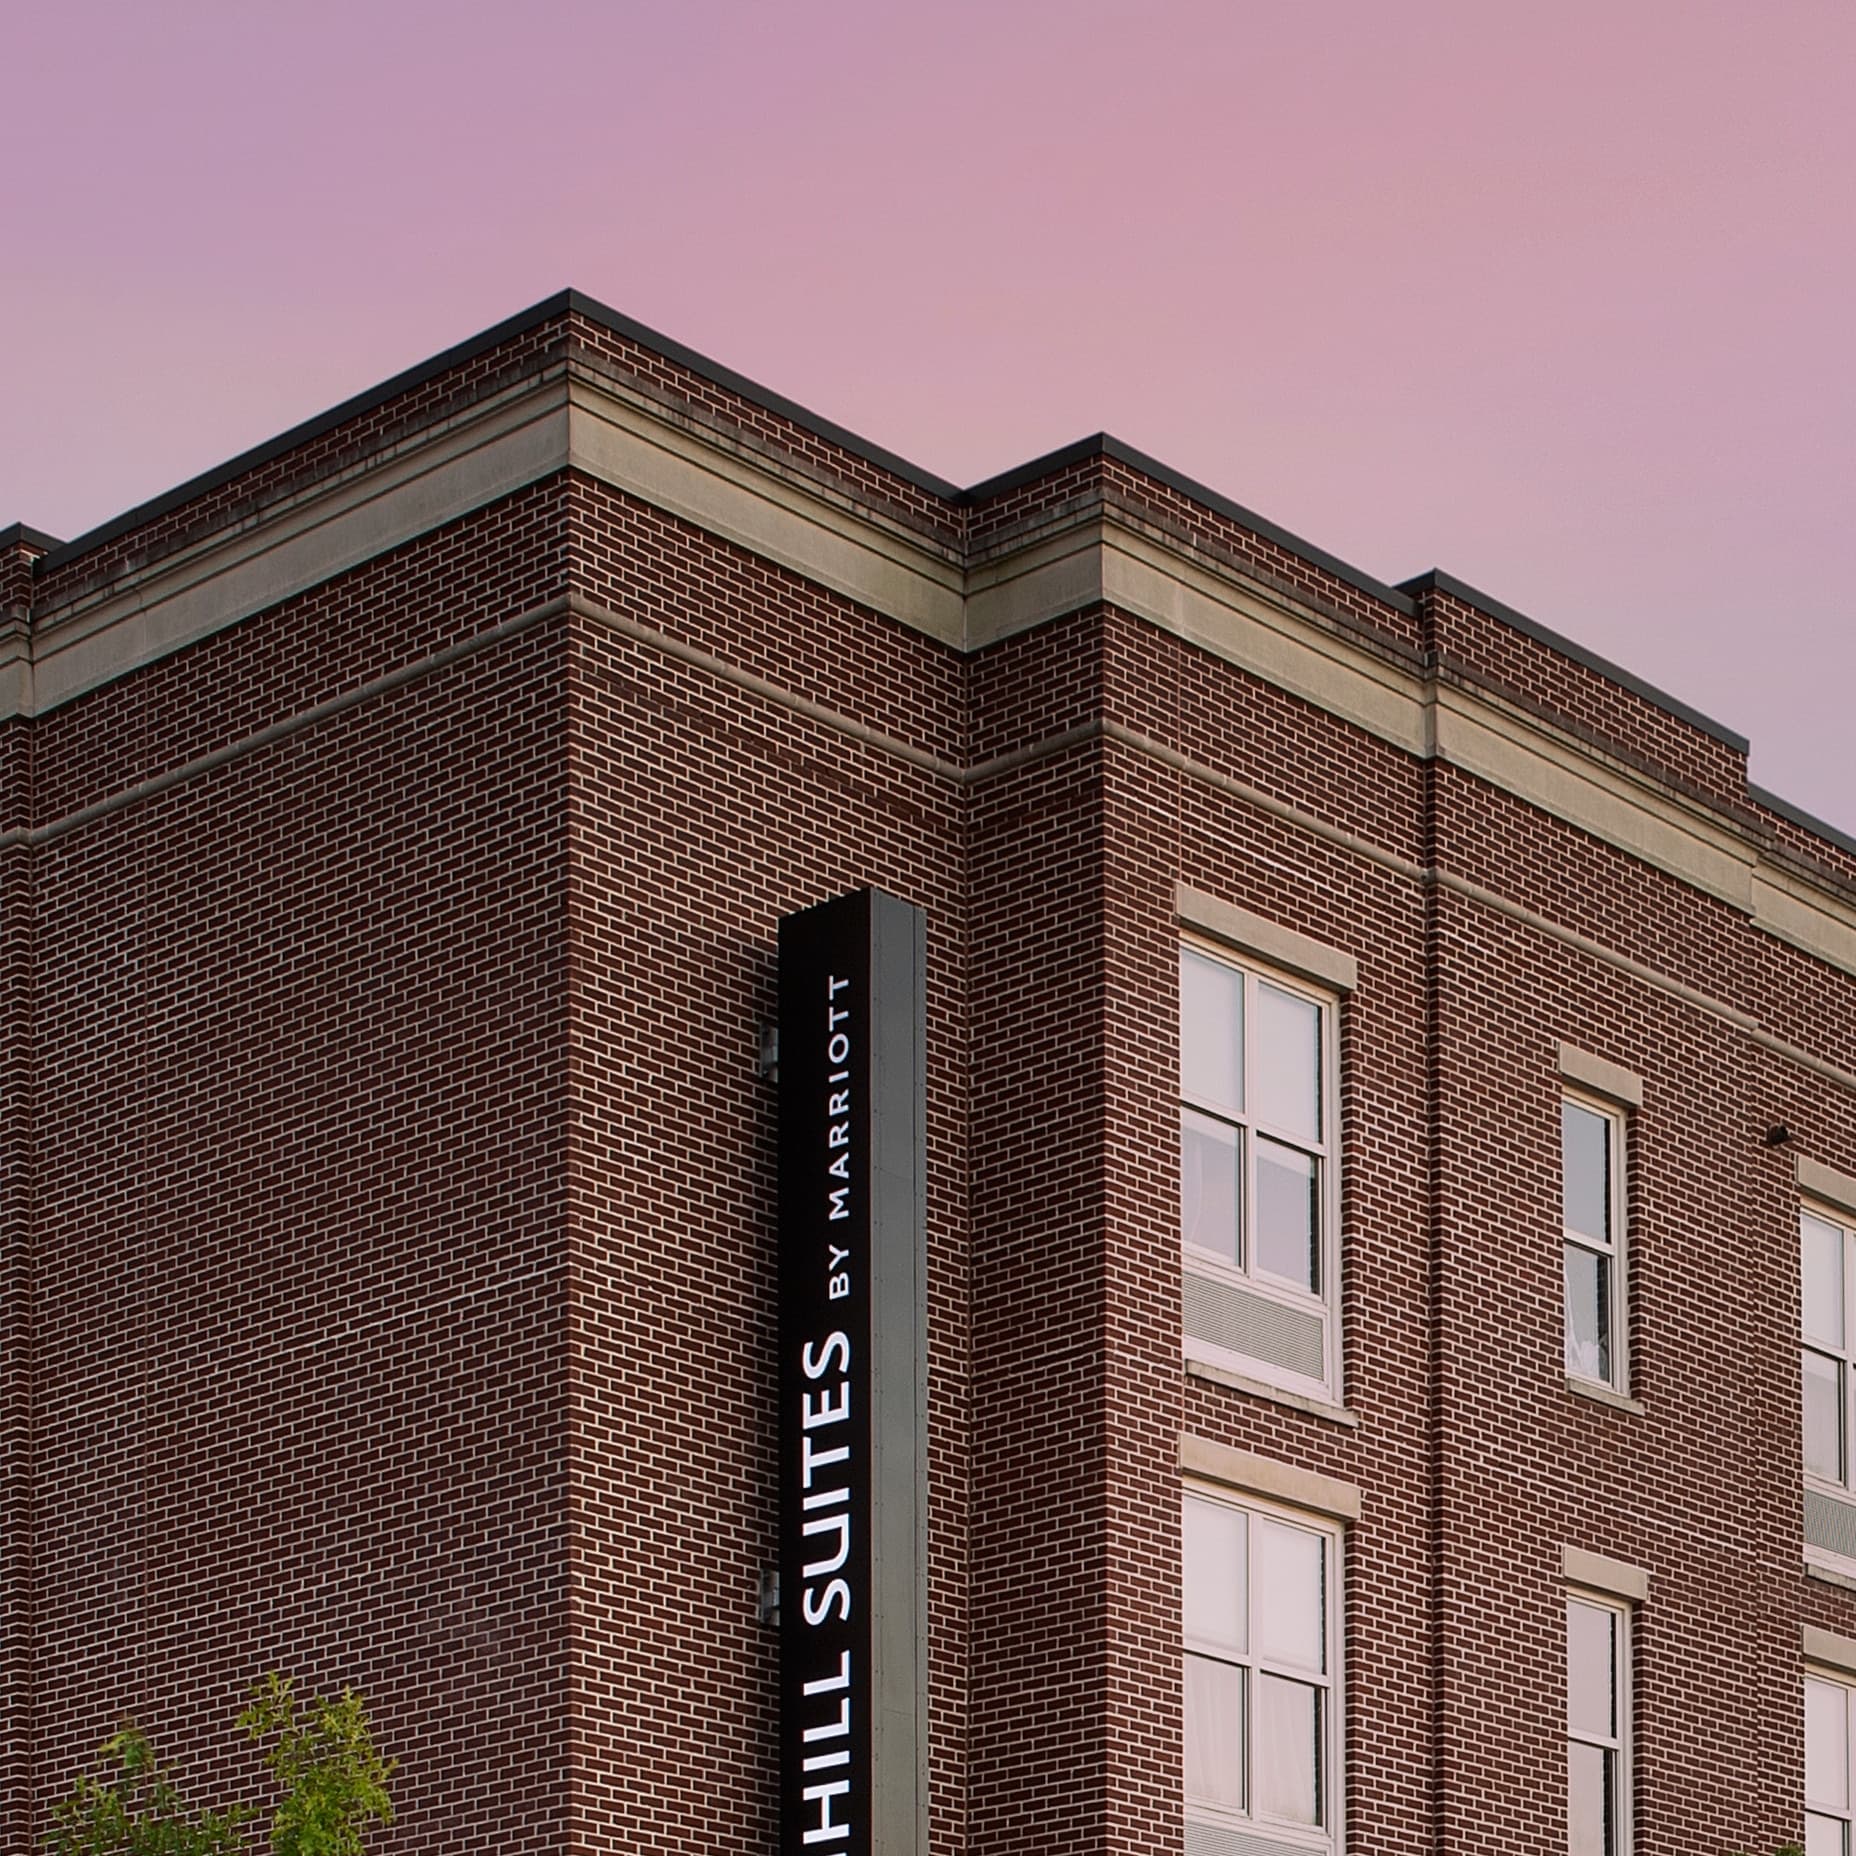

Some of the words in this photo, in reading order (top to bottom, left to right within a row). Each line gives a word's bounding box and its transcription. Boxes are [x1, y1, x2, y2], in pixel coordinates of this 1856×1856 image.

[828, 975, 850, 1221] MARRIOTT
[828, 1244, 850, 1300] BY
[802, 1331, 851, 1627] SUITES
